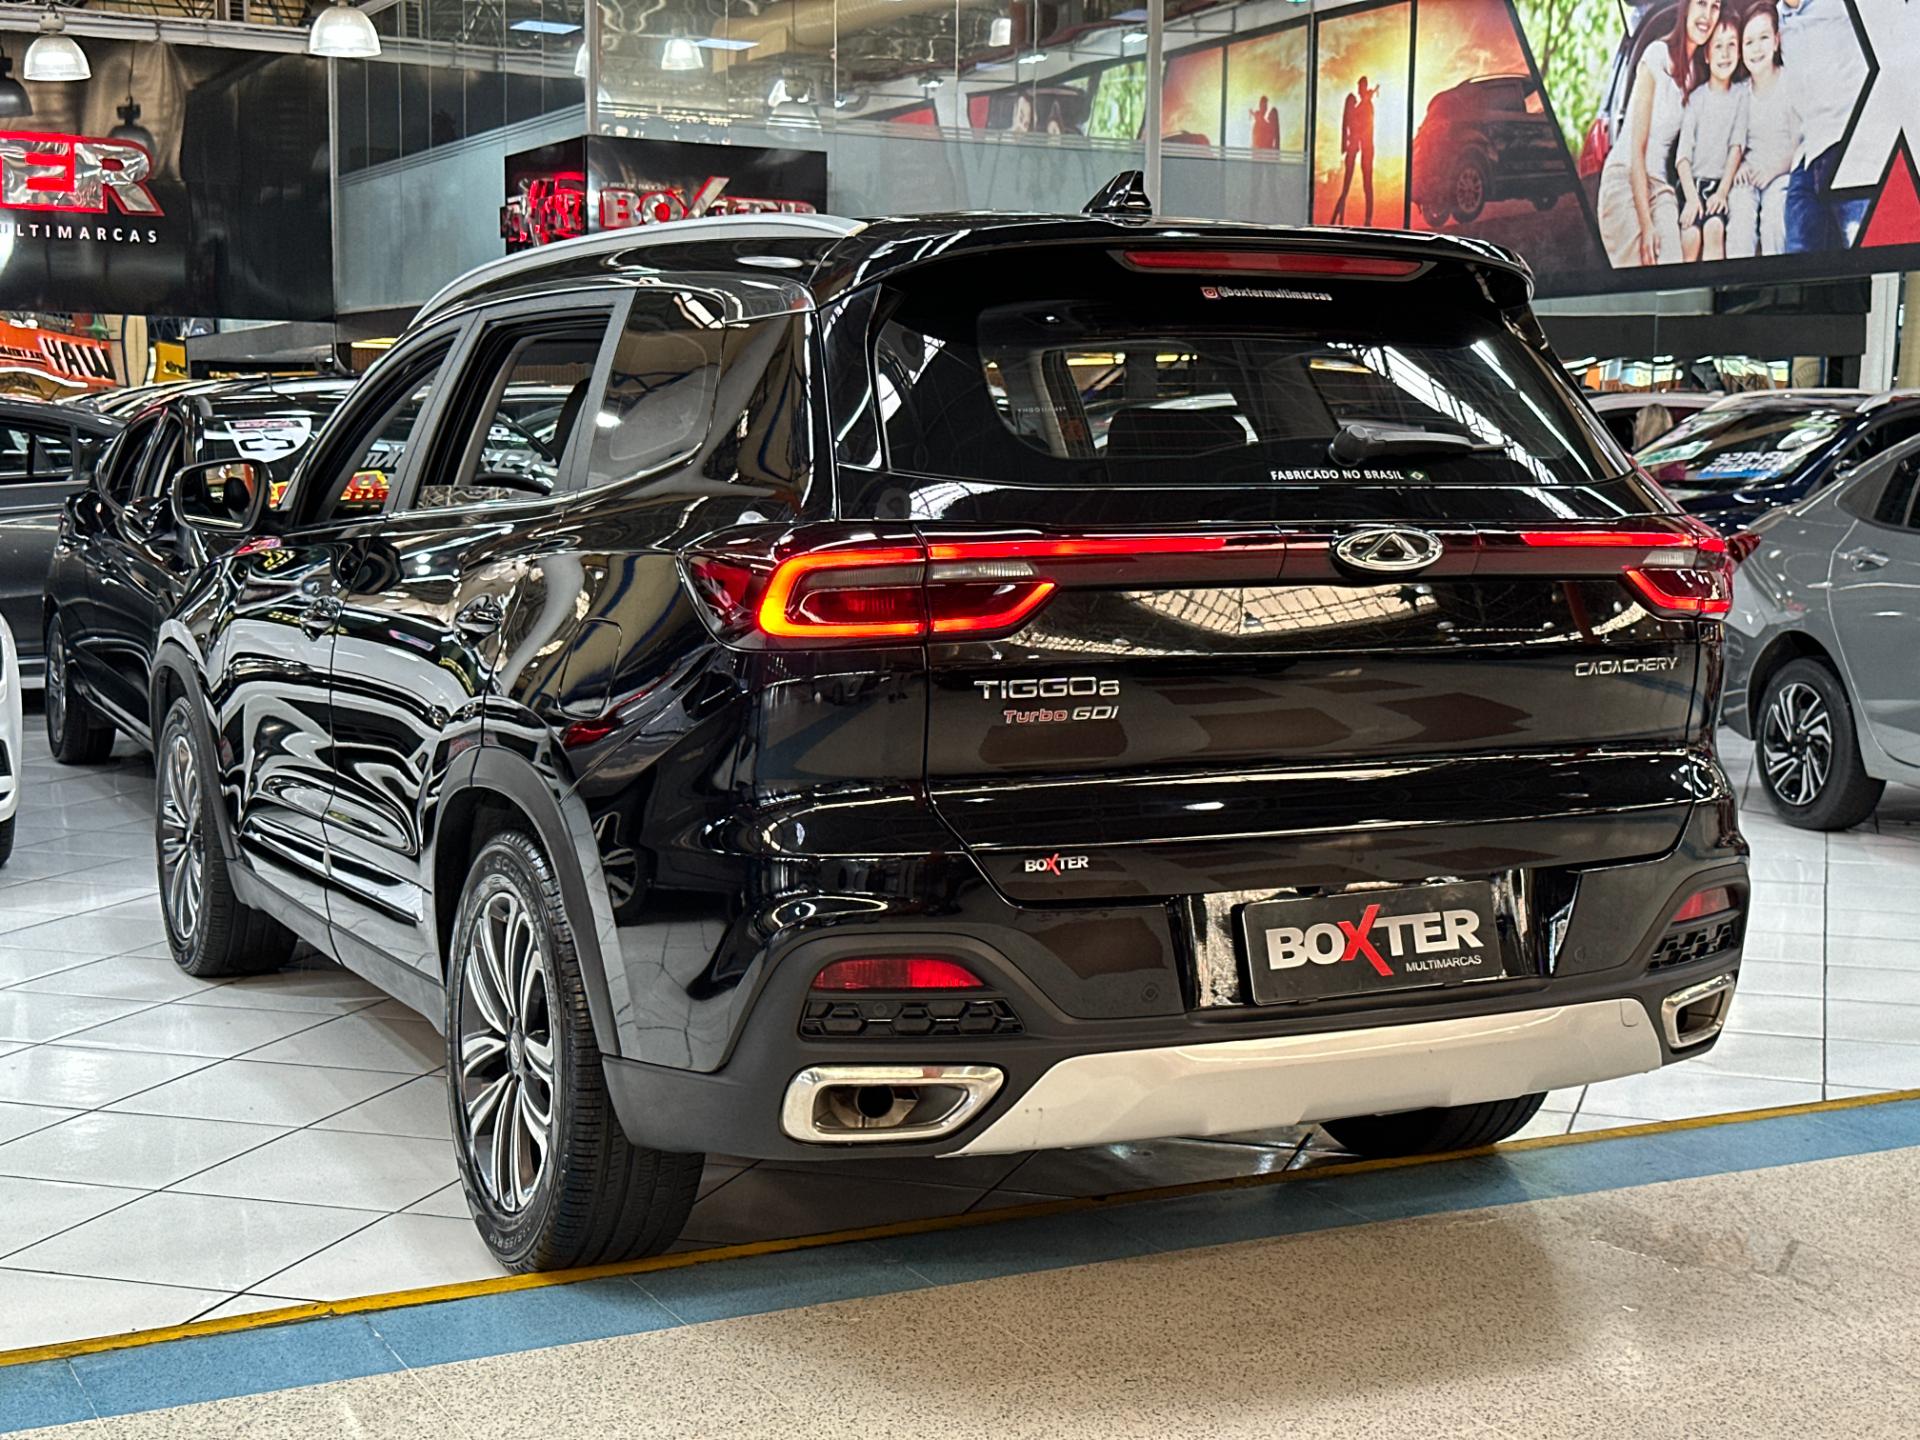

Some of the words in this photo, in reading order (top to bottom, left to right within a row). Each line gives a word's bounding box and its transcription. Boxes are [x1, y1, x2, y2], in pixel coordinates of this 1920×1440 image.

[0, 130, 165, 216] ER
[1270, 469, 1340, 481] FABRICADO
[1342, 469, 1362, 479] NO
[1363, 469, 1405, 480] BRASIL
[1003, 708, 1069, 724] Turbo
[1071, 705, 1120, 721] GDI
[1024, 853, 1090, 876] BOXTER
[1265, 903, 1485, 977] BOXTER
[1405, 954, 1483, 973] MULTIMARCAS
